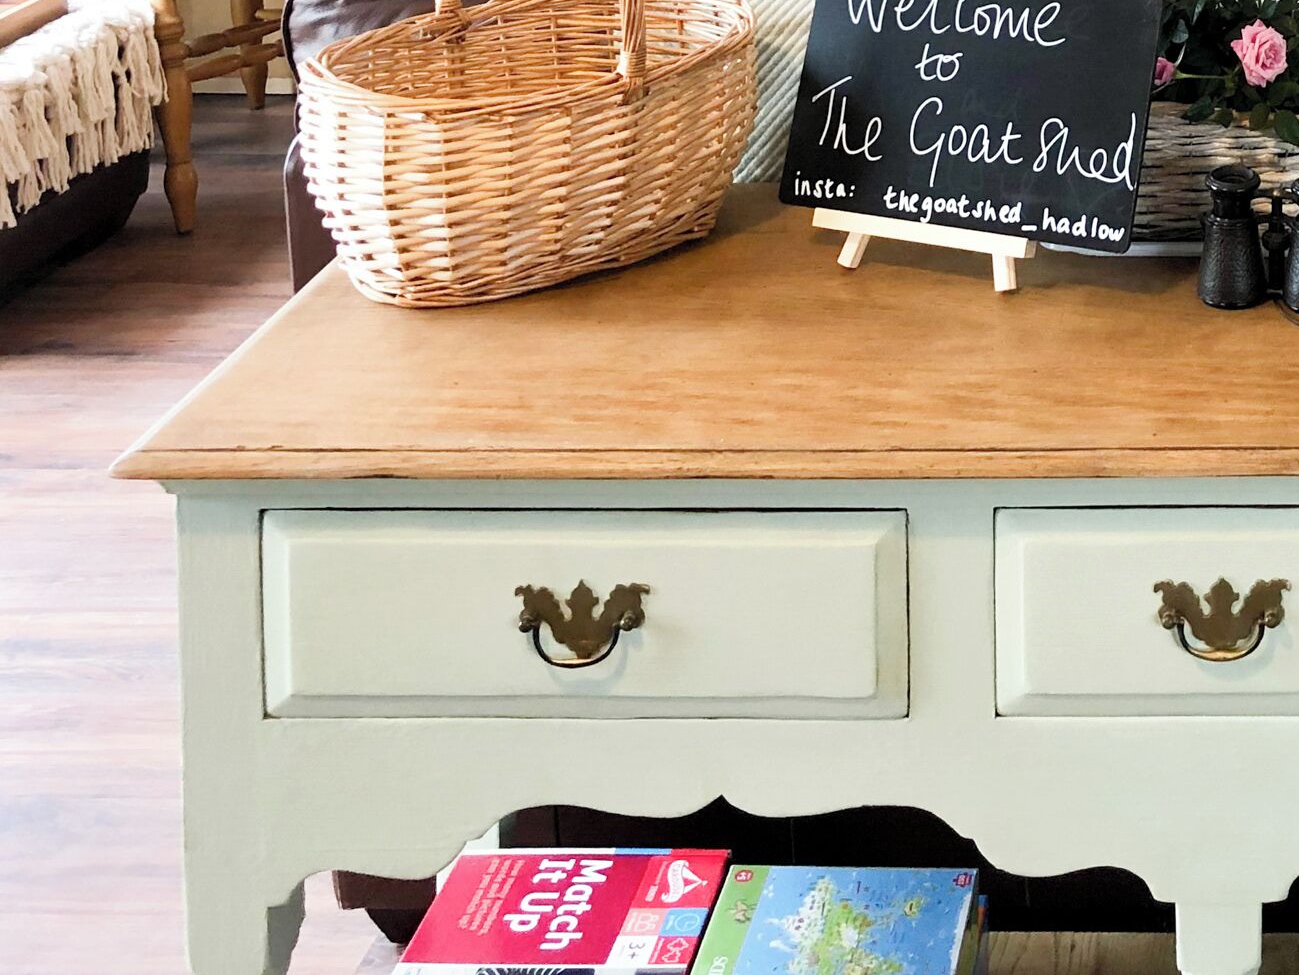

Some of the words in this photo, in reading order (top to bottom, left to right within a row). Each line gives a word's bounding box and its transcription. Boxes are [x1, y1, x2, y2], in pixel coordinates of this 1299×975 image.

[914, 43, 963, 82] to
[811, 76, 883, 162] The
[910, 97, 1023, 187] Goat
[794, 171, 855, 198] insta:
[532, 858, 577, 883] It
[503, 892, 561, 932] Up
[540, 860, 613, 950] Match
[628, 941, 645, 959] 3+
